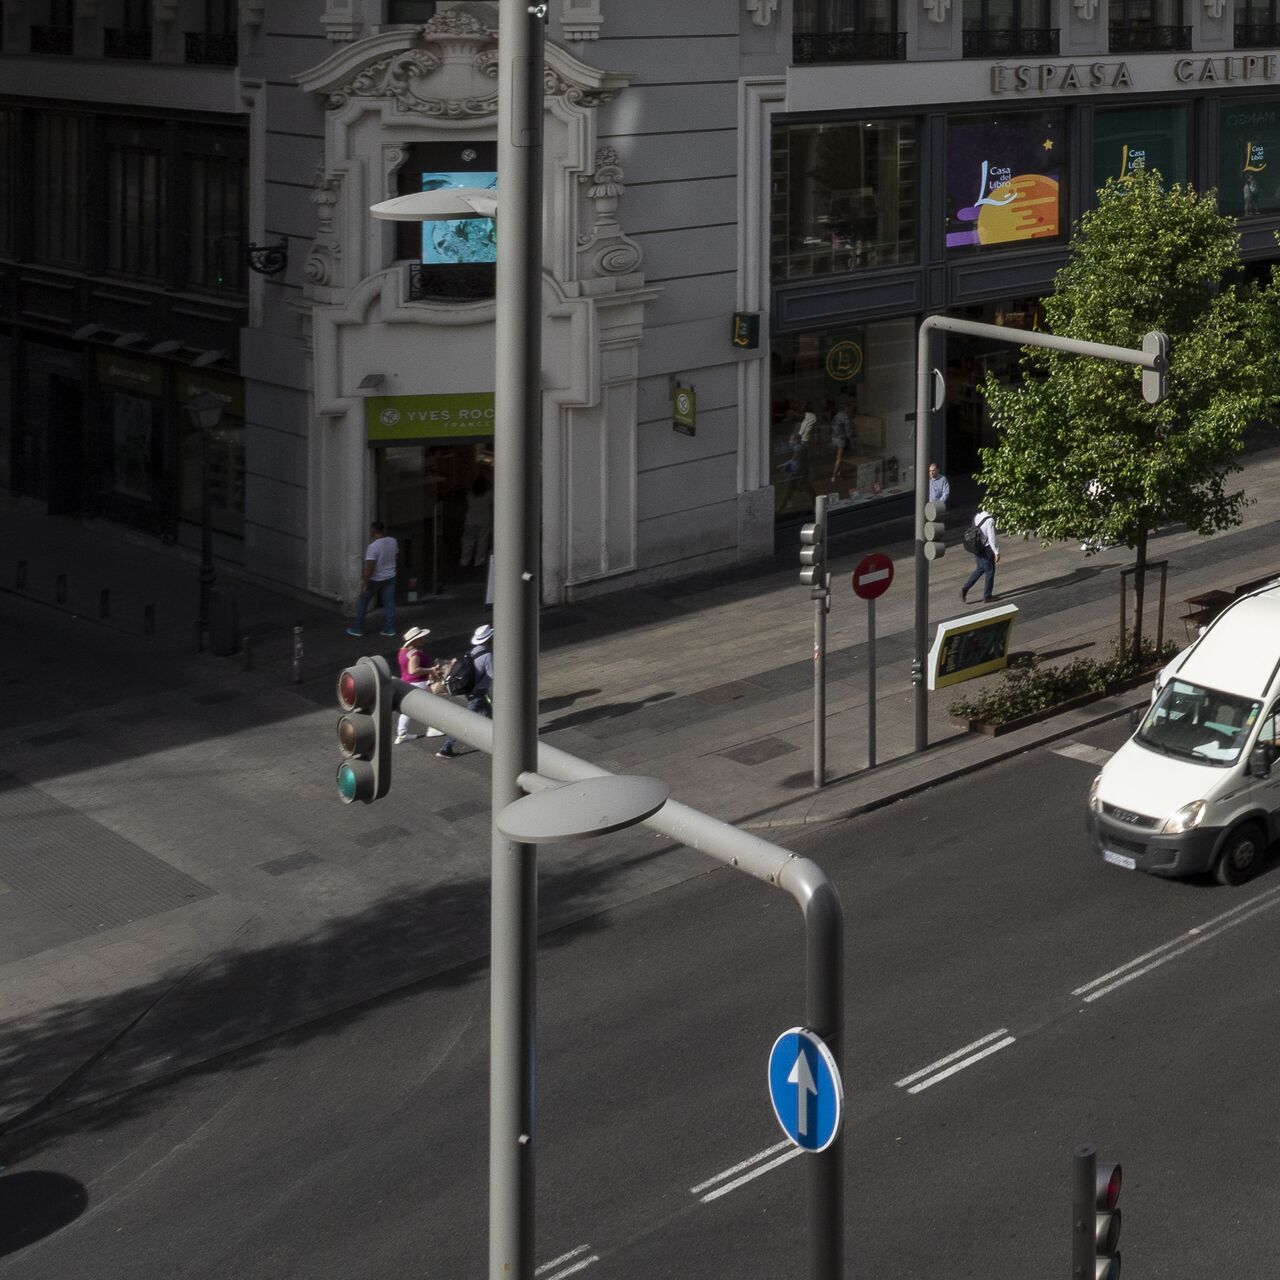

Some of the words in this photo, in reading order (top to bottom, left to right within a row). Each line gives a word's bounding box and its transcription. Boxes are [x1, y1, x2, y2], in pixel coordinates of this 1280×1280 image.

[991, 61, 1134, 94] ESPASA
[1175, 54, 1278, 82] CALPE
[990, 166, 1011, 175] Casa
[990, 181, 1011, 189] Libro
[407, 410, 450, 422] YVES
